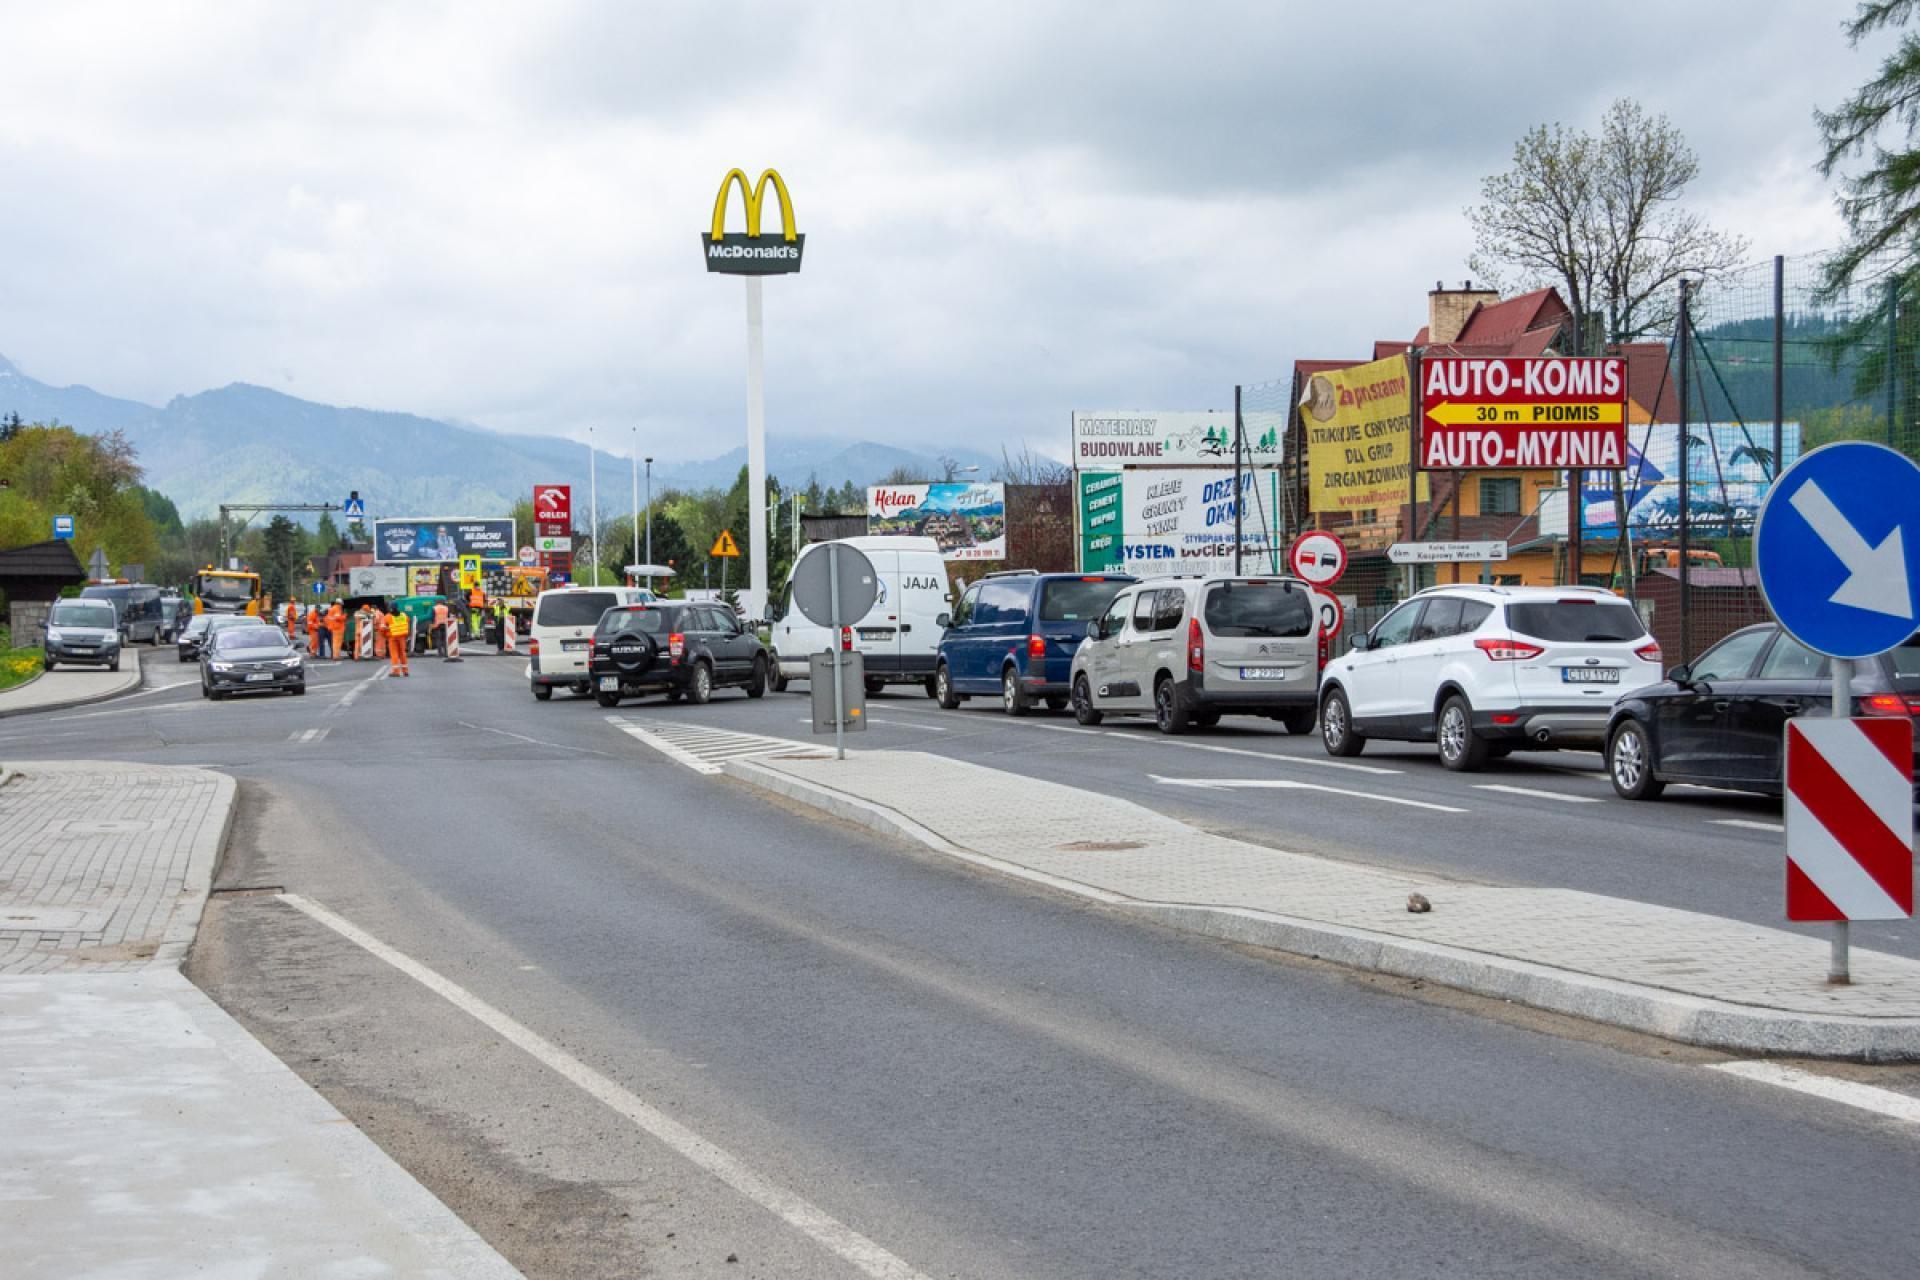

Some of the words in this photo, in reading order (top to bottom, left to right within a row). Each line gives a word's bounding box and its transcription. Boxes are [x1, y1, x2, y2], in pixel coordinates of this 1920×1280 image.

[709, 245, 799, 259] McDonald's
[1426, 360, 1620, 396] AUTO-KOMIS
[1476, 406, 1497, 421] 30
[1504, 410, 1519, 421] m
[1533, 406, 1599, 421] PIOMIS
[1081, 442, 1163, 457] BUDOWLANE
[1427, 431, 1620, 466] AUTO-MYJNIA
[875, 489, 916, 513] Helan
[1142, 496, 1187, 520] GRUNTY
[539, 511, 567, 519] ORLEN
[1115, 544, 1174, 559] SYSTEM
[903, 577, 939, 590] JAJA
[611, 646, 645, 654] SUZUKI
